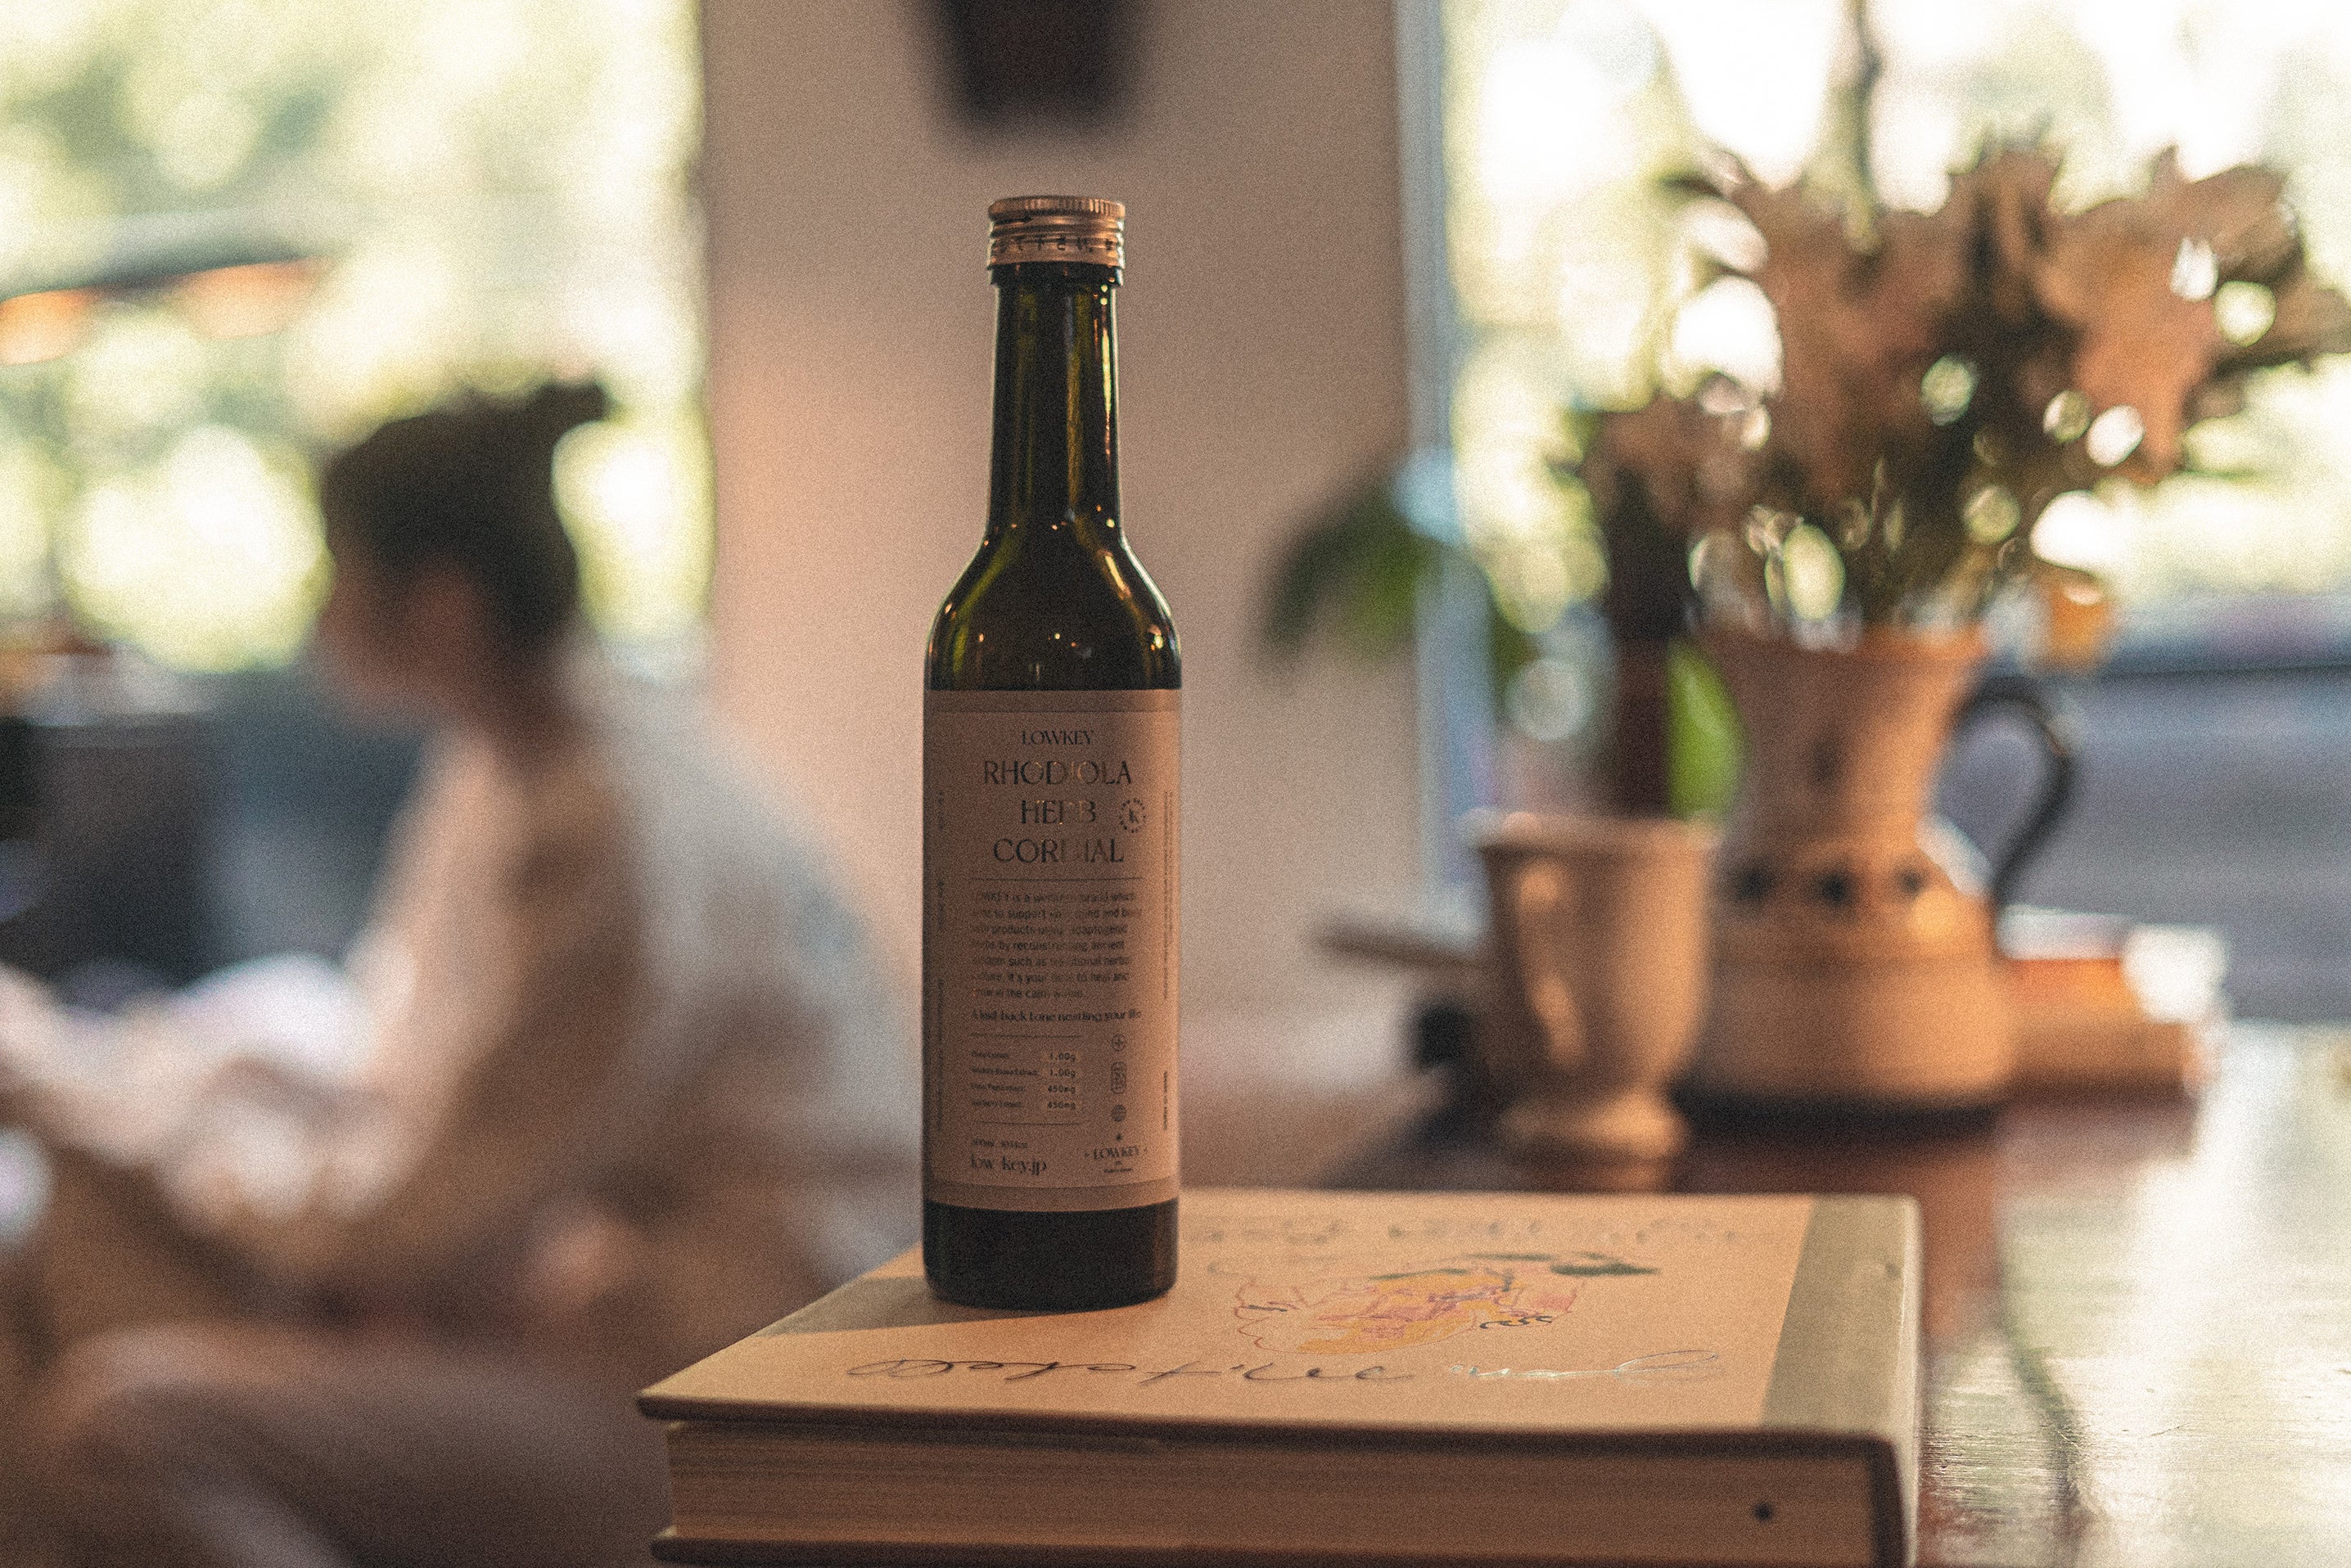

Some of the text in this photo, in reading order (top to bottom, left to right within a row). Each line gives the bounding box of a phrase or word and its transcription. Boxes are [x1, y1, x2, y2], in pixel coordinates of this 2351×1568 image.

[1022, 729, 1094, 746] LOWKEY
[1008, 956, 1032, 967] such
[1049, 1052, 1076, 1063] 1.00g
